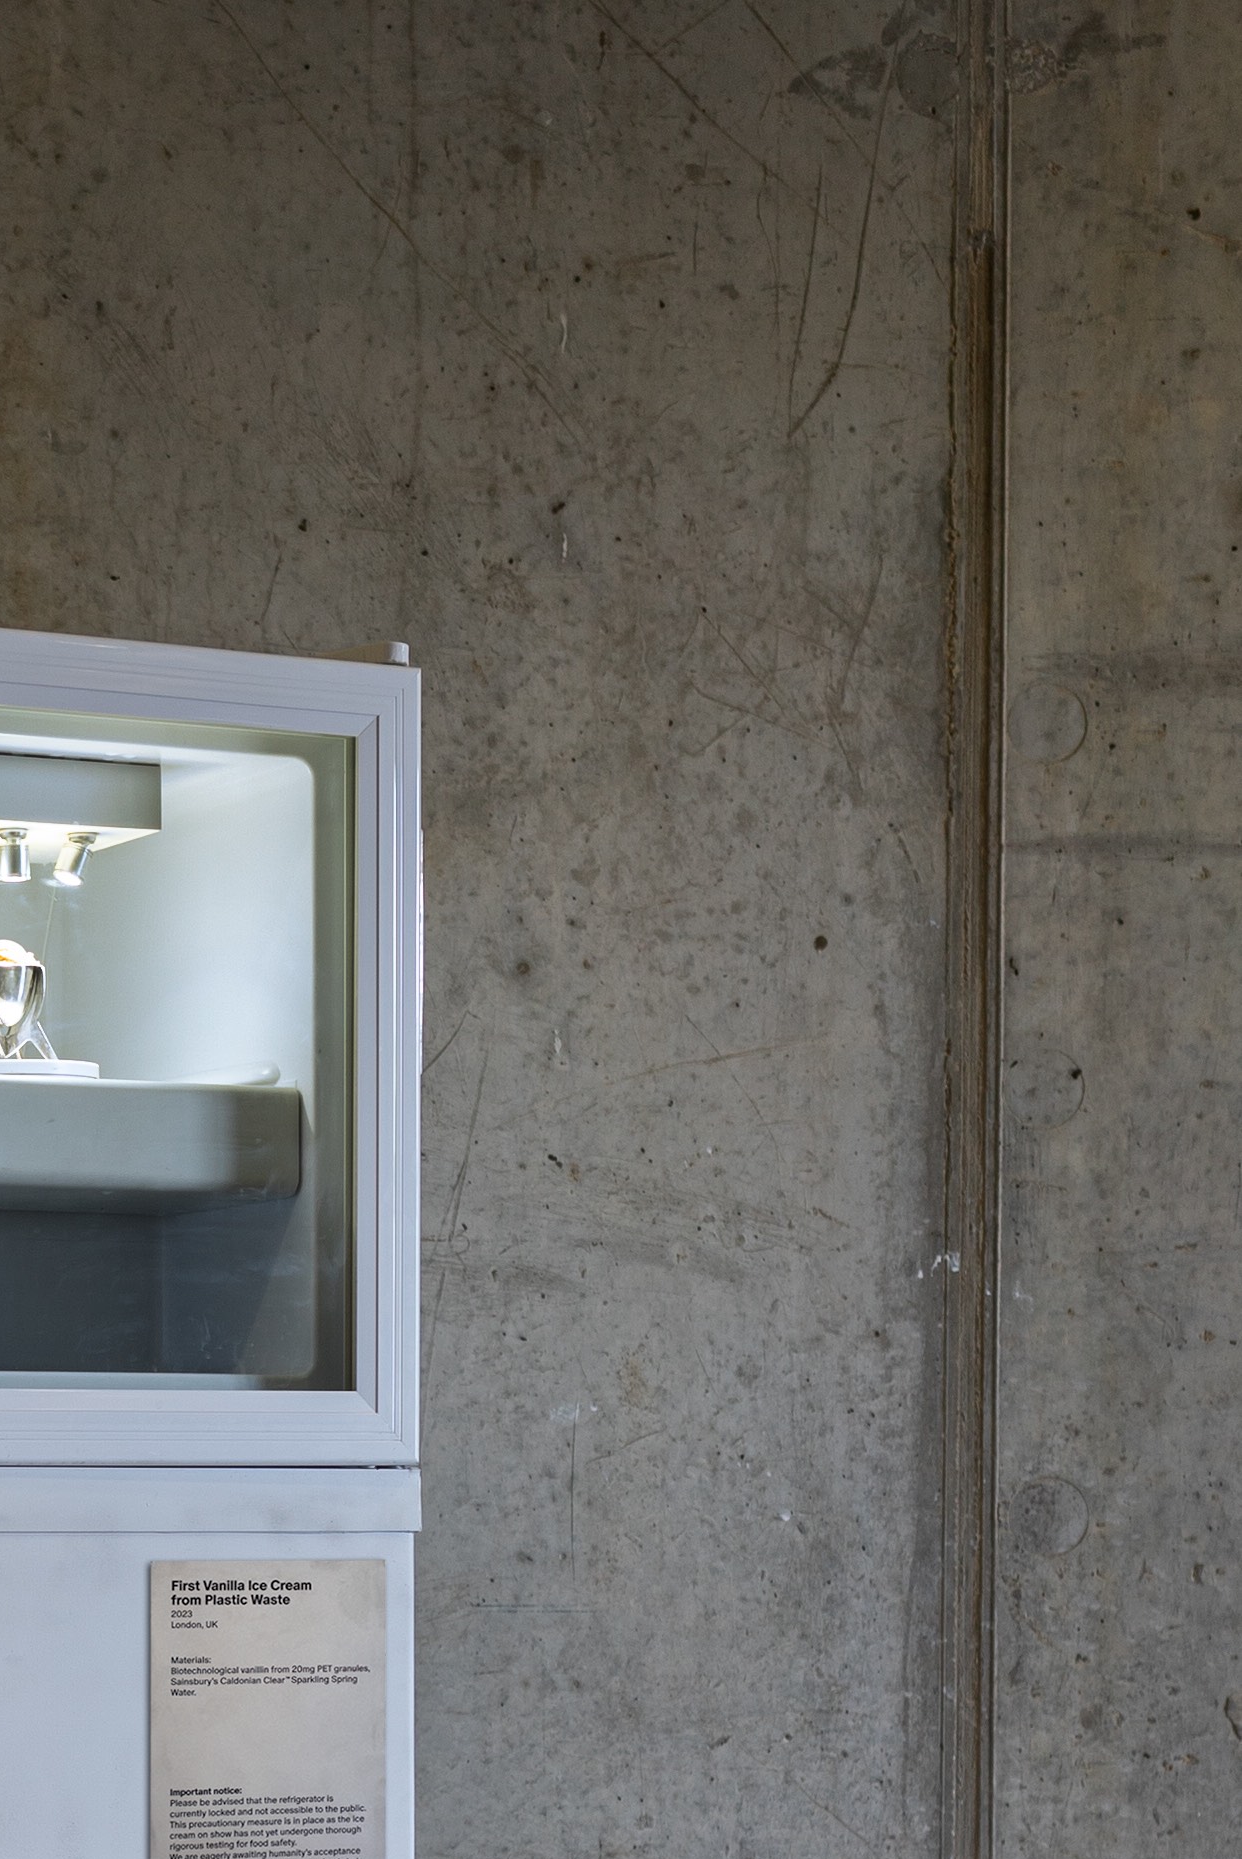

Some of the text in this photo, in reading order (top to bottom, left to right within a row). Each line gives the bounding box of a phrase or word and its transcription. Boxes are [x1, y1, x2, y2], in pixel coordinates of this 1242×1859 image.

[171, 1579, 312, 1591] First Vanilla Ice Cream
[171, 1594, 291, 1606] from Plastic Waste
[171, 1621, 204, 1629] London,
[171, 1666, 240, 1677] Biotechnological
[291, 1665, 315, 1675] 20mg
[333, 1664, 371, 1674] granules,
[219, 1677, 262, 1685] Caldonian
[331, 1675, 358, 1685] Spring
[170, 1787, 242, 1798] Important notice:
[170, 1799, 198, 1807] Please
[211, 1797, 244, 1806] advised
[246, 1797, 262, 1805] that
[279, 1795, 325, 1806] refrigerator
[169, 1809, 207, 1820] currently
[208, 1808, 236, 1817] locked
[237, 1808, 253, 1816] and
[270, 1806, 314, 1815] accessible
[339, 1804, 367, 1814] public.
[169, 1821, 187, 1829] This
[188, 1819, 246, 1830] precautionary
[302, 1816, 325, 1826] place
[210, 1830, 232, 1838] show
[265, 1828, 279, 1838] yet
[280, 1827, 324, 1838] undergone
[325, 1826, 362, 1836] thorough
[169, 1842, 204, 1852] rigorous
[206, 1841, 235, 1851] testing
[249, 1840, 269, 1848] food
[270, 1838, 297, 1849] safety.
[313, 1847, 361, 1858] acceptance
